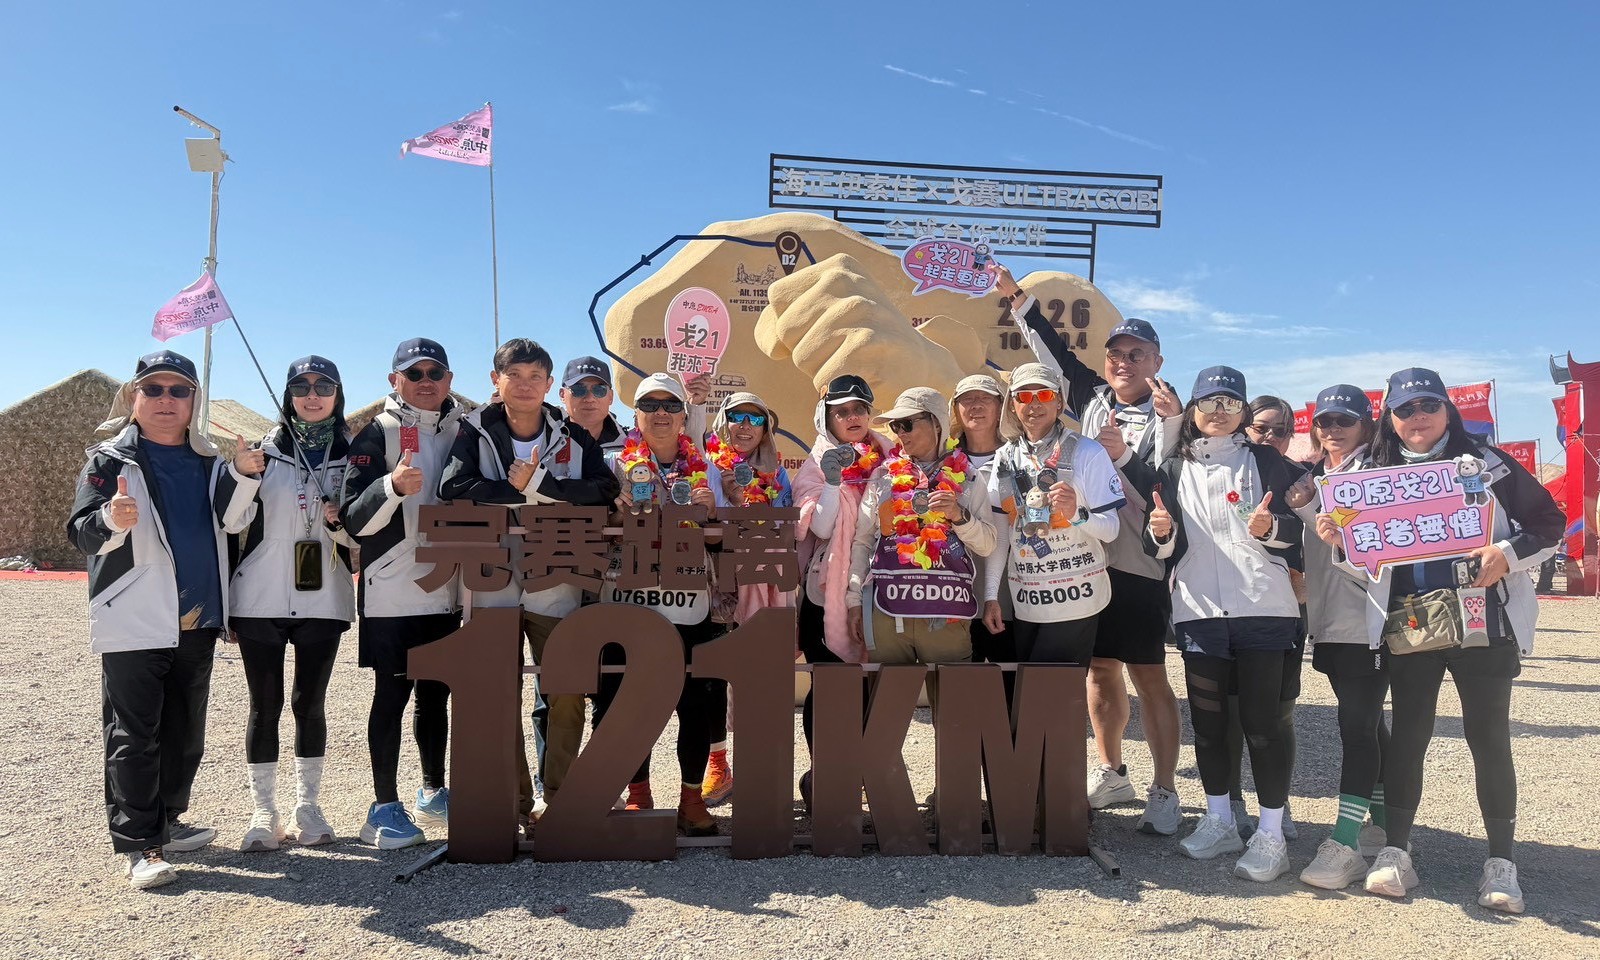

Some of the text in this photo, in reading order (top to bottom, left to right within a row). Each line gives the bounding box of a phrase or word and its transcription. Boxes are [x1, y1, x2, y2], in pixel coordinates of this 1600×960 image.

[781, 254, 796, 267] D2
[928, 242, 970, 267] 戈21
[997, 296, 1091, 329] 226
[674, 322, 720, 350] 戈21
[670, 352, 719, 376] 我來了
[1333, 468, 1454, 508] 中原戈21
[1350, 506, 1484, 552] 勇者無懼
[413, 500, 802, 594] 完赛距离
[1015, 551, 1096, 575] 中原大学商学院
[612, 588, 698, 608] 076B007
[886, 583, 970, 603] 076D020
